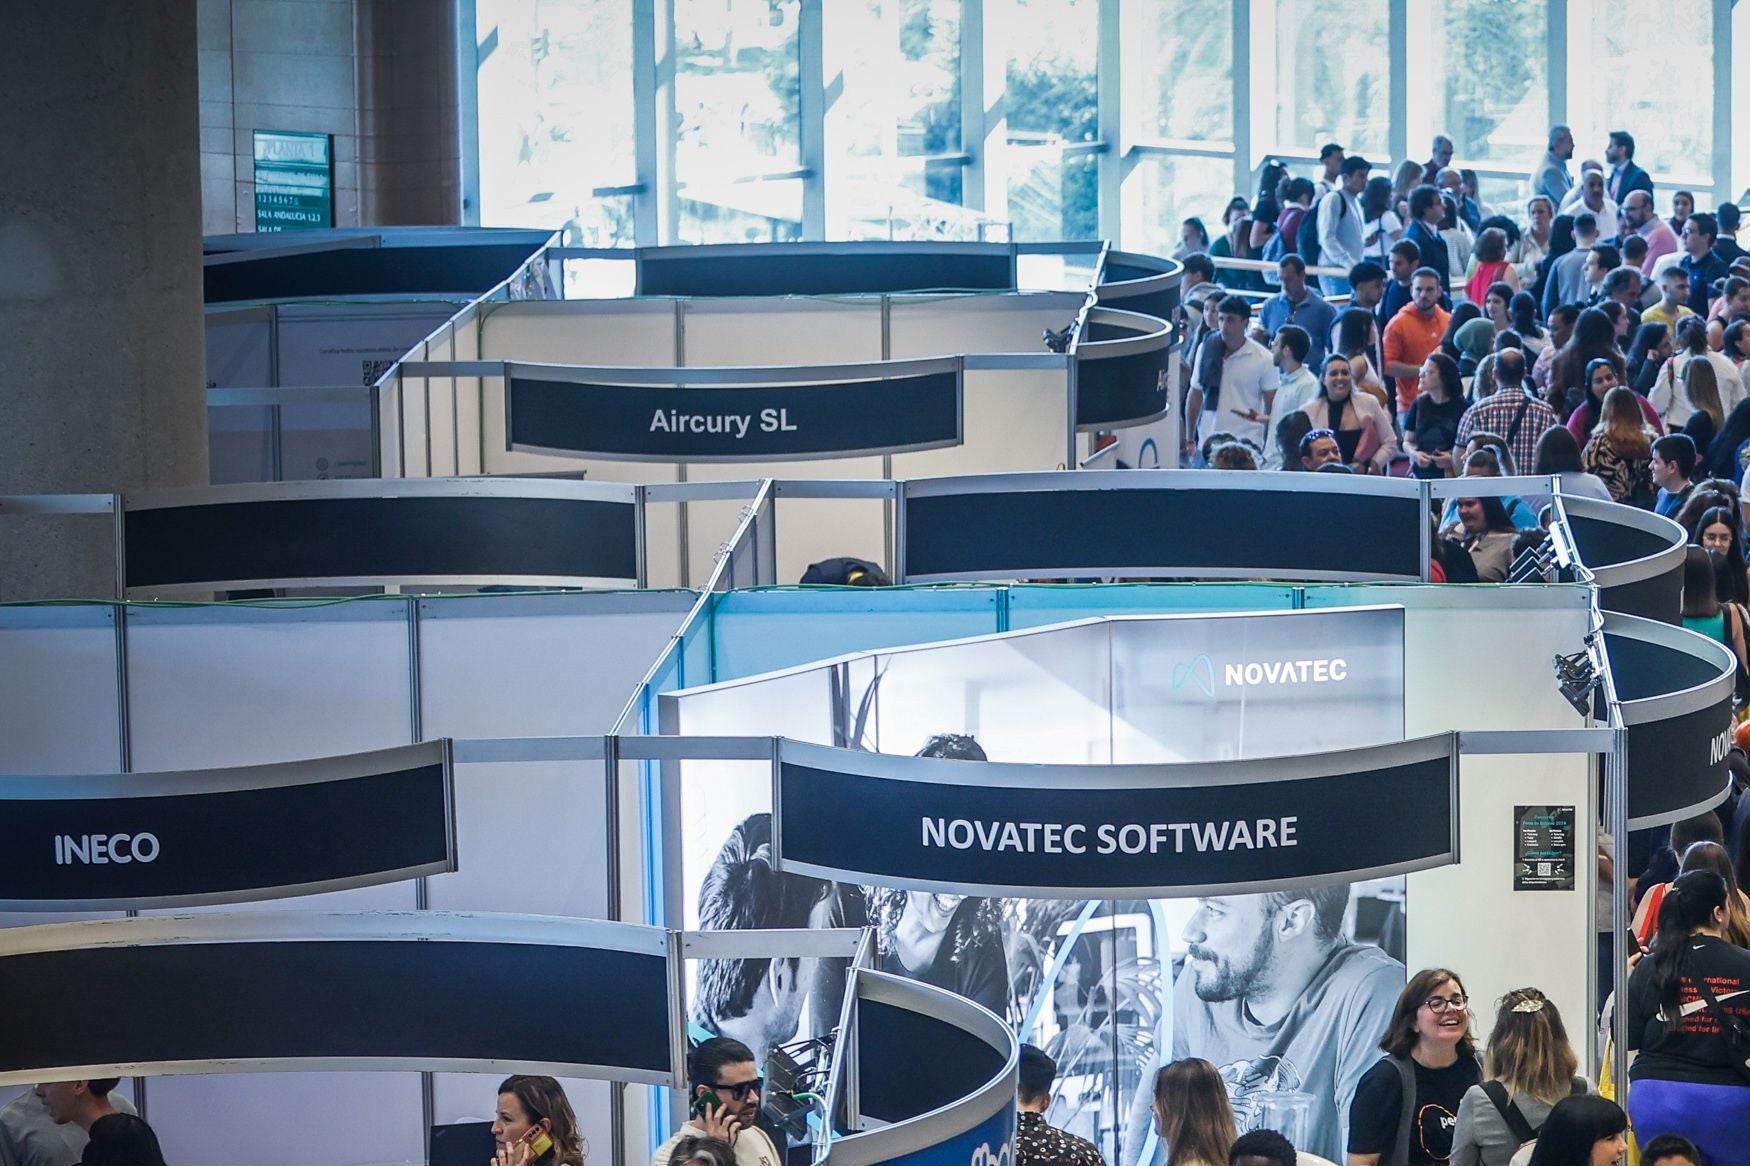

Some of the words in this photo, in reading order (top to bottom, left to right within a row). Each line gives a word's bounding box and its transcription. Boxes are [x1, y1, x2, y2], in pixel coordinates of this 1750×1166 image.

[257, 209, 272, 219] SALA
[650, 409, 751, 438] Aircury
[760, 408, 798, 433] SL
[1225, 658, 1348, 687] NOVATEC
[54, 832, 160, 865] INECO
[921, 816, 1087, 854] NOVATEC
[1097, 815, 1299, 855] SOFTWARE
